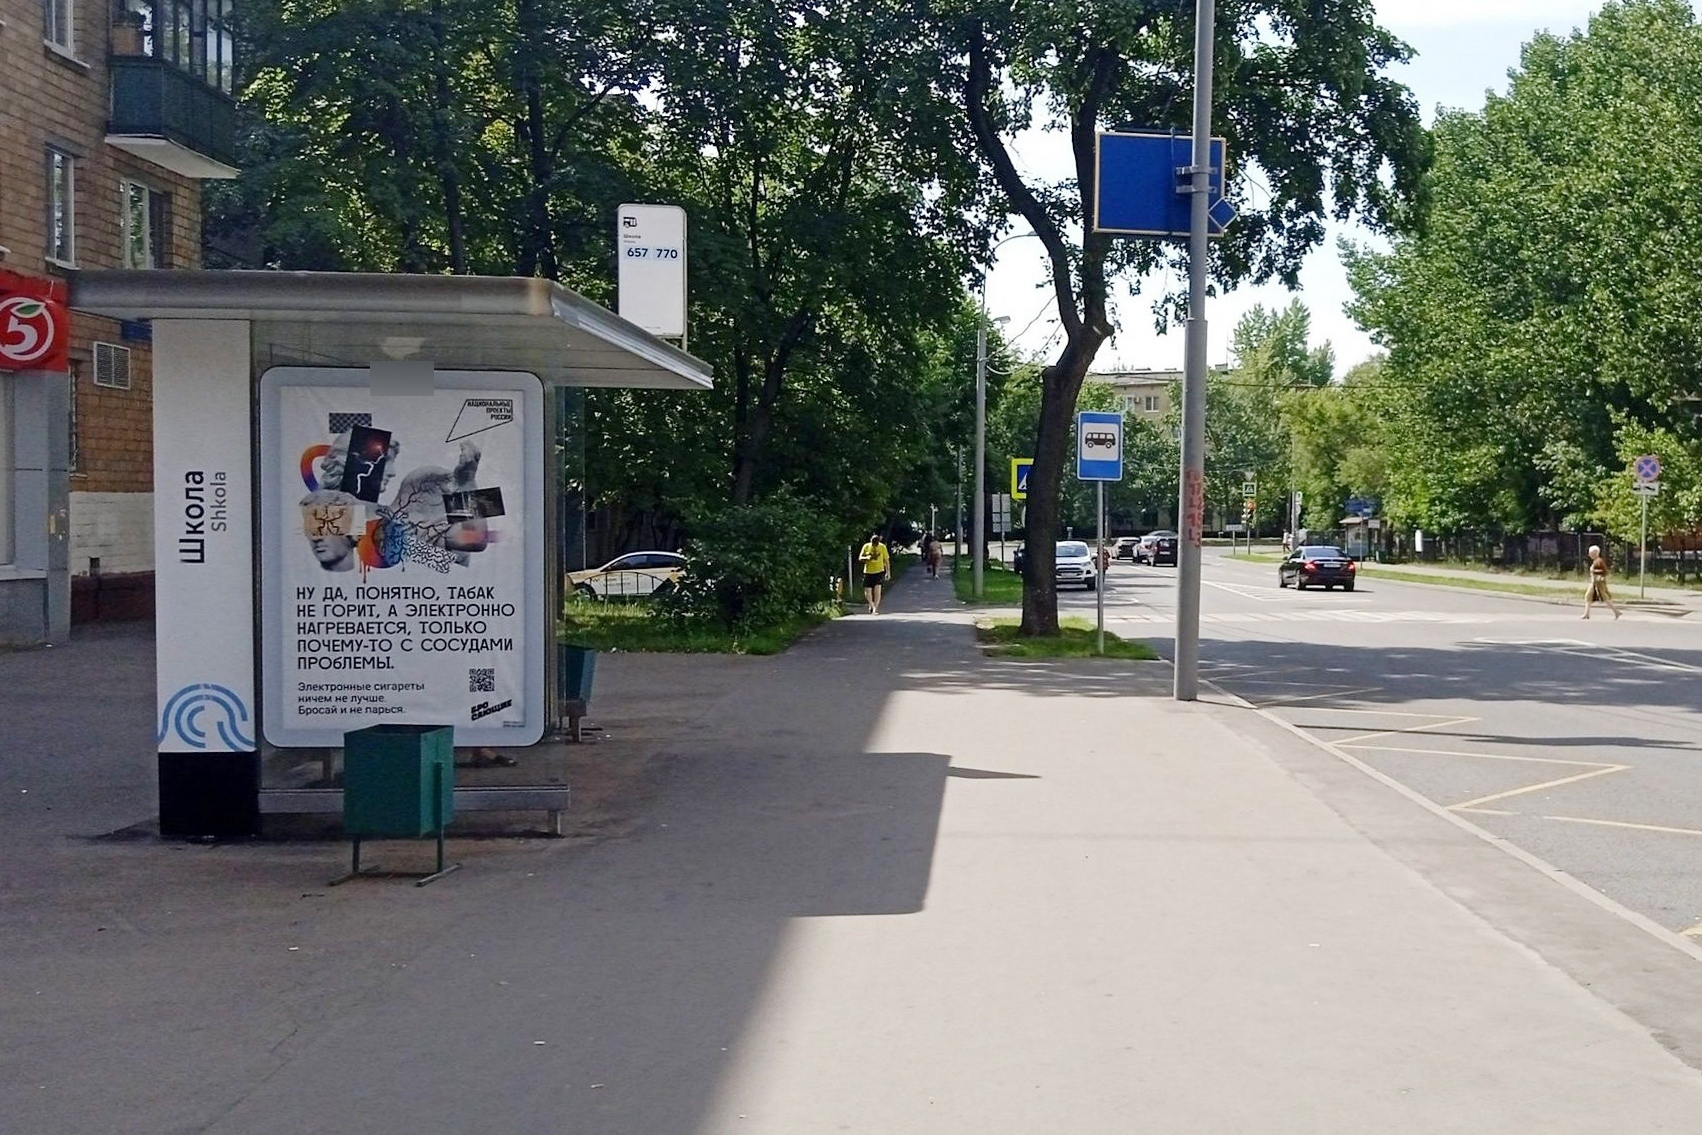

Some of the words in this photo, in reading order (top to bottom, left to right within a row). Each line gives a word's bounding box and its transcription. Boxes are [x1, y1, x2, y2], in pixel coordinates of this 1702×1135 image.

[627, 247, 648, 258] 657
[656, 248, 678, 259] 770
[210, 471, 227, 532] Shkola
[179, 470, 205, 564] Школа
[296, 586, 315, 600] НУ
[322, 586, 348, 602] ДА,
[356, 586, 440, 601] ПОНЯТНО,
[297, 604, 316, 617] НЕ
[323, 604, 380, 618] ГОРИТ,
[388, 604, 398, 617] А
[405, 603, 516, 617] ЭЛЕКТРОННО
[297, 621, 411, 636] НАГРЕВАЕТСЯ,
[419, 621, 487, 635] ТОЛЬКО
[297, 638, 393, 652] ПОЧЕМУ-ТО
[400, 638, 413, 652] С
[421, 638, 513, 653] СОСУДАМИ
[298, 682, 371, 692] Электронные
[374, 683, 425, 692] сигареты
[298, 705, 338, 716] Бросай
[350, 706, 362, 714] не
